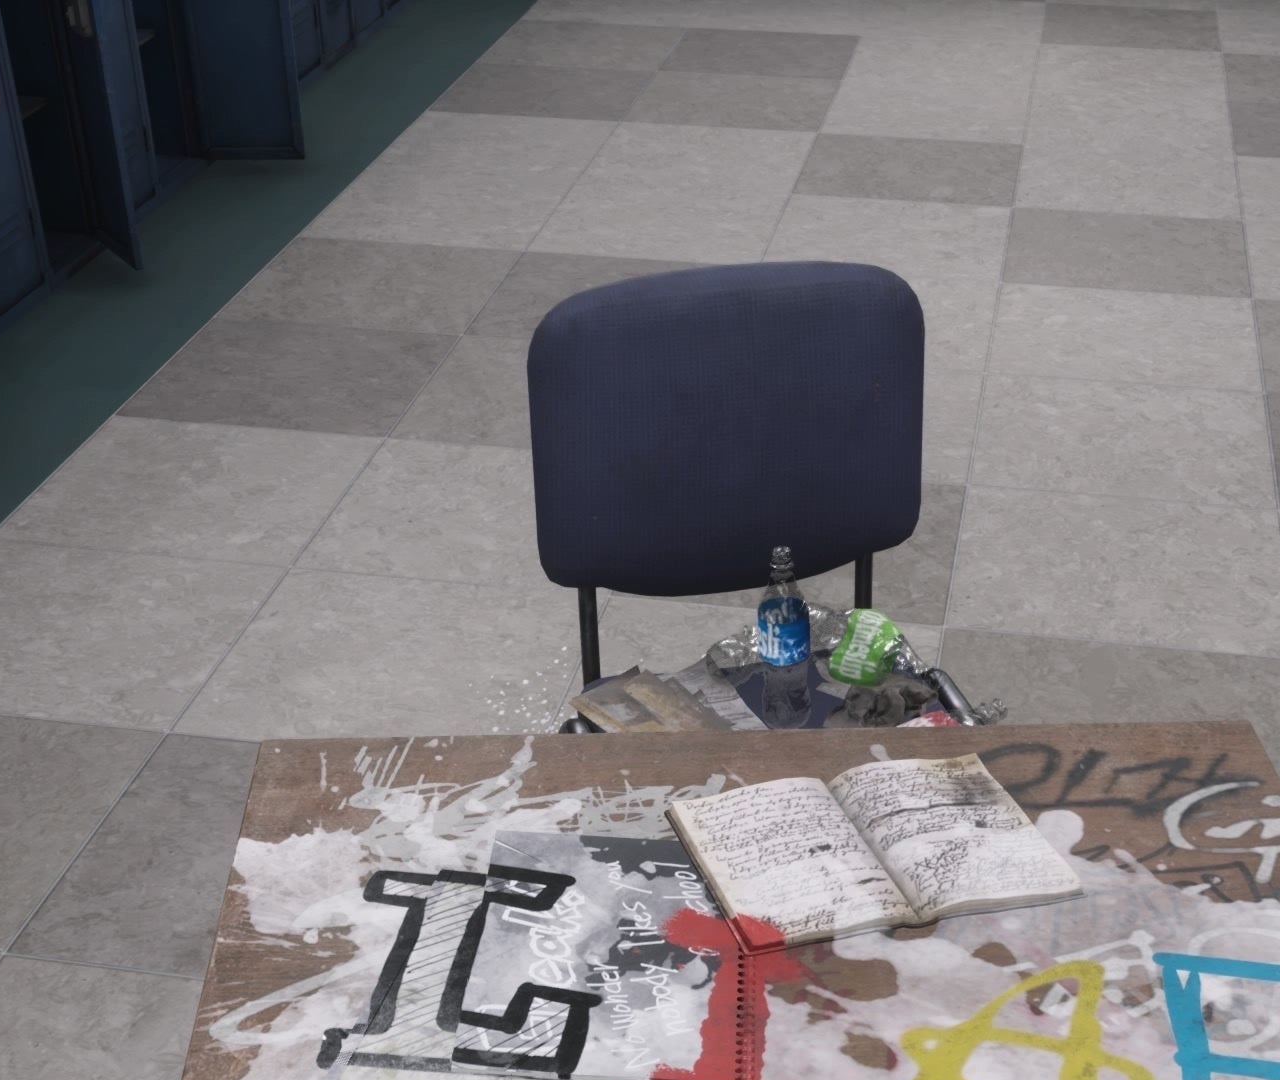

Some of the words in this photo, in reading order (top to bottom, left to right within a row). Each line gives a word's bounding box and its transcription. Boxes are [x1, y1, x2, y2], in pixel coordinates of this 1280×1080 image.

[607, 860, 653, 895] you
[654, 861, 709, 915] chool
[617, 900, 665, 947] likes
[631, 962, 695, 1037] nobody
[624, 1033, 661, 1072] No
